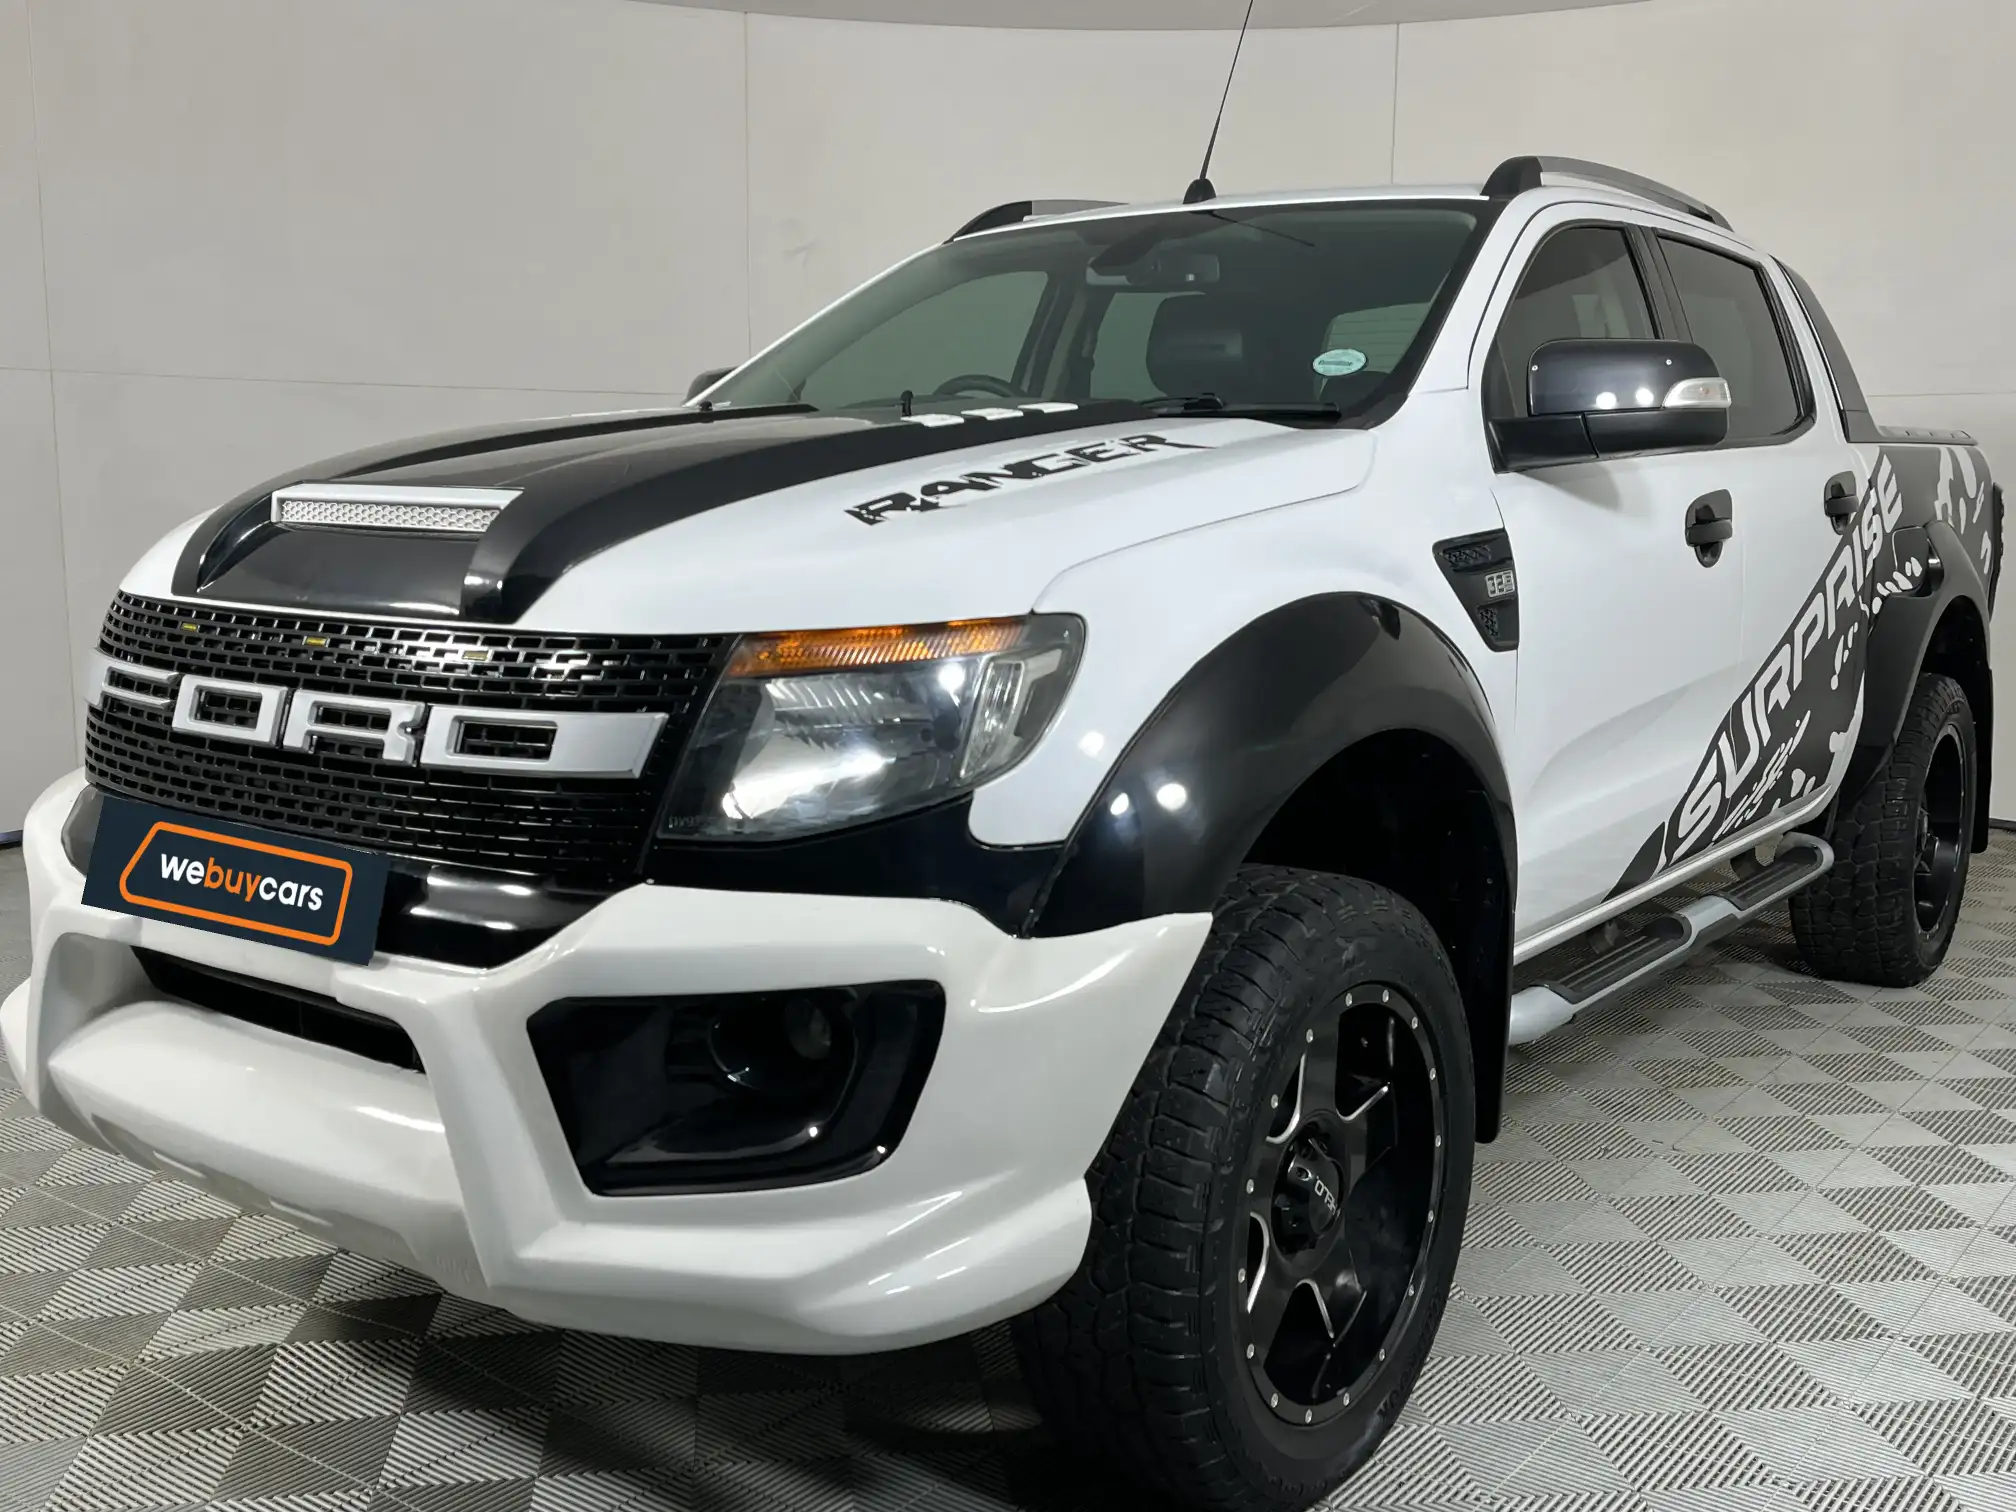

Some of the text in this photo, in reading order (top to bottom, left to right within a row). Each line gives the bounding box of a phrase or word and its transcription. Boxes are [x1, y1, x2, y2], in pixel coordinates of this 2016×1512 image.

[843, 433, 1218, 526] RANGER
[84, 644, 669, 779] FORD
[1668, 454, 1903, 867] SURPRISE
